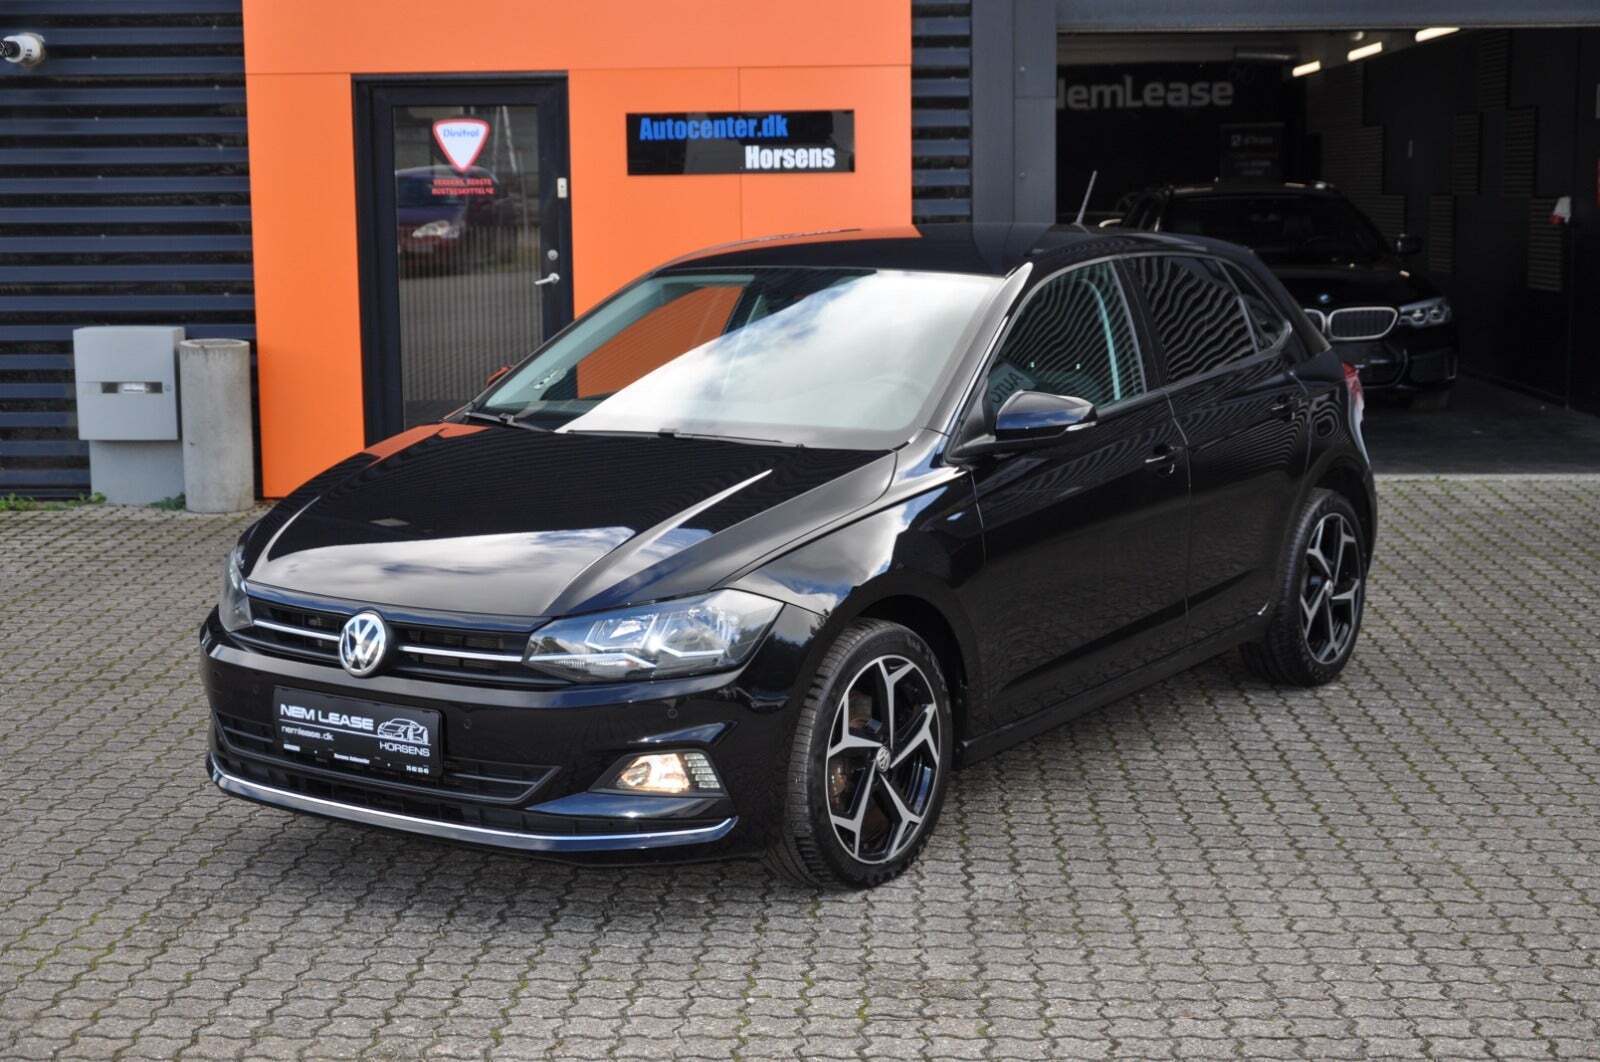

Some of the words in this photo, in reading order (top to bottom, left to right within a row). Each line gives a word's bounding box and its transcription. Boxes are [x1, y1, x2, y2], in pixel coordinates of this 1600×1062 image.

[443, 127, 480, 138] Dinitrol
[639, 114, 788, 141] Autocenter.dk
[745, 145, 835, 169] Horsens
[280, 703, 315, 721] NEM
[318, 709, 374, 731] LEASE
[281, 725, 334, 741] nemlease.dk
[379, 741, 430, 757] HORSENS
